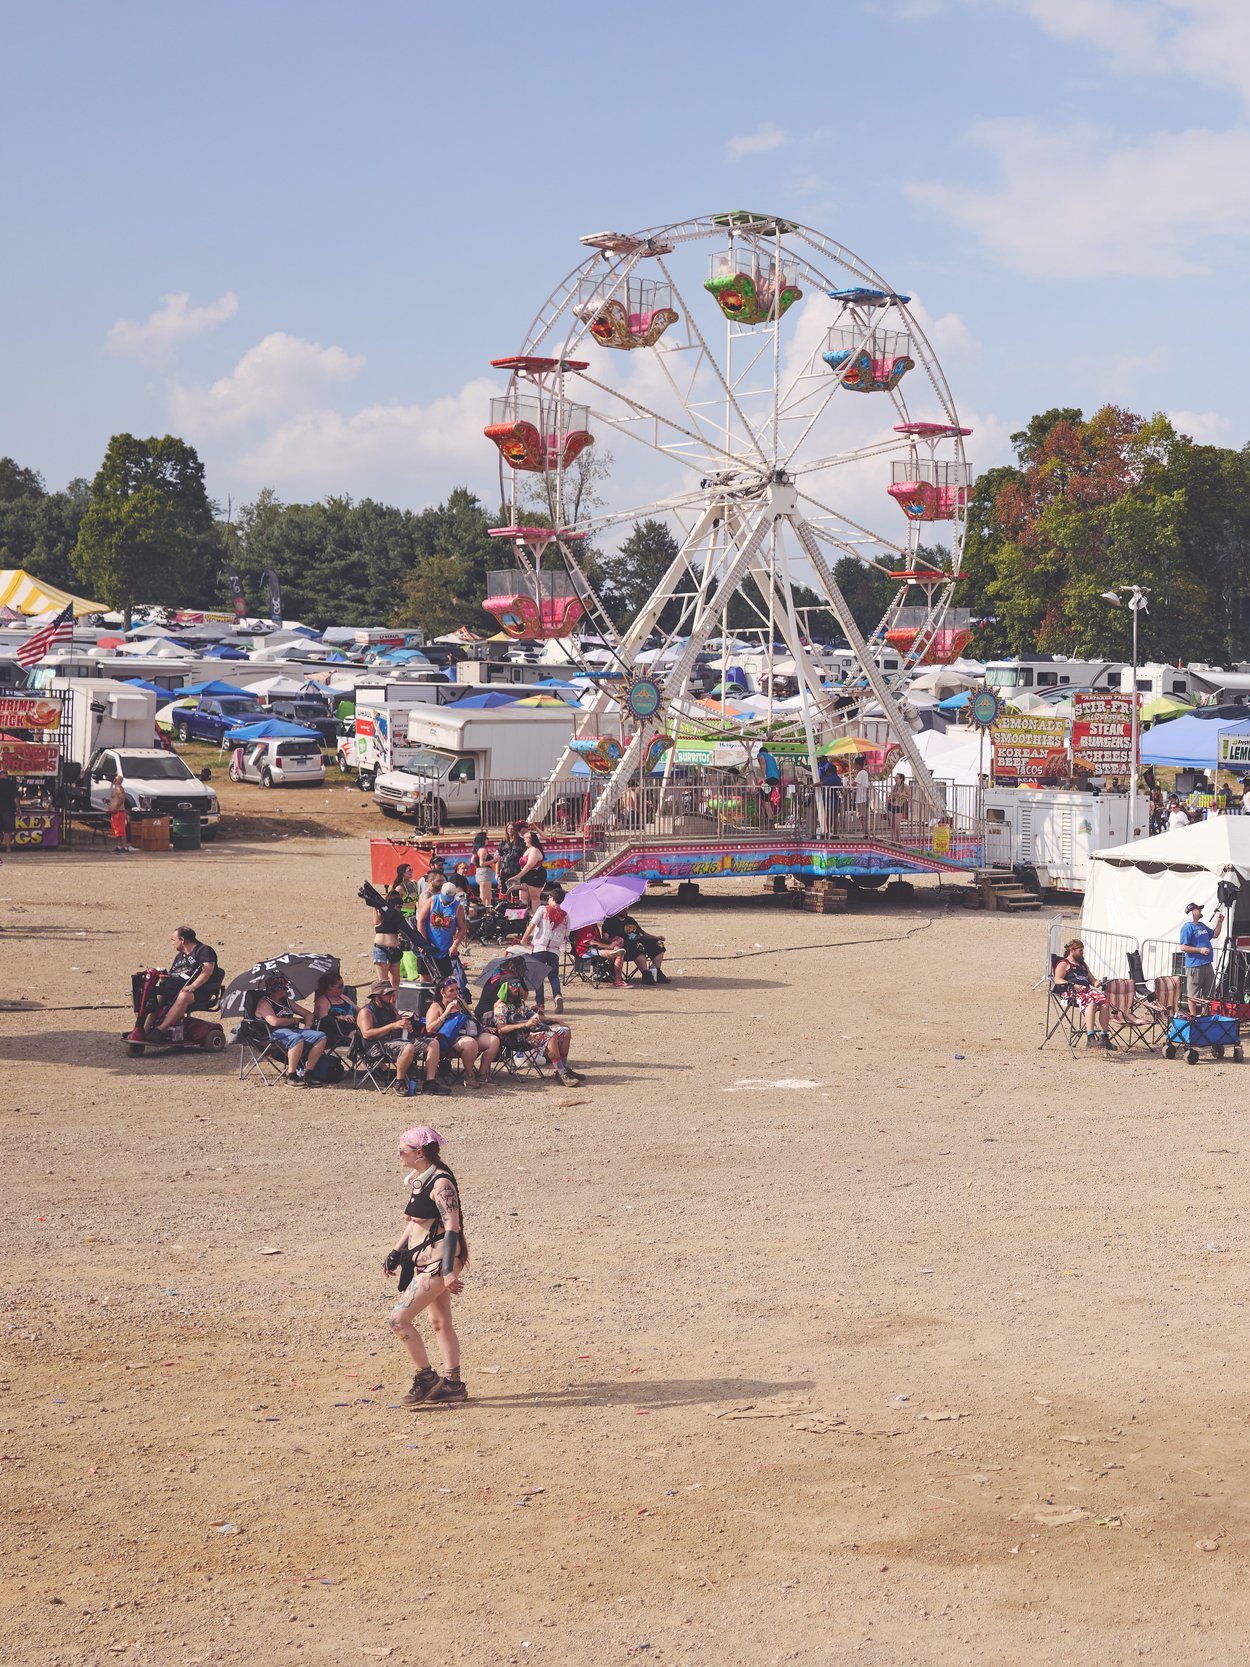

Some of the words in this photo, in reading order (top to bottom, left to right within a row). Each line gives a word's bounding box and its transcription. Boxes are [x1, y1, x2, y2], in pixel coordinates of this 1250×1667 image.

[1089, 723, 1125, 735] STEAK
[994, 732, 1061, 747] SMOOTHIES
[1080, 735, 1131, 748] BURGERS
[997, 748, 1049, 758] KOREAN
[997, 758, 1029, 767] BEEF
[1016, 765, 1043, 775] TACOS
[669, 862, 718, 876] FERRIS
